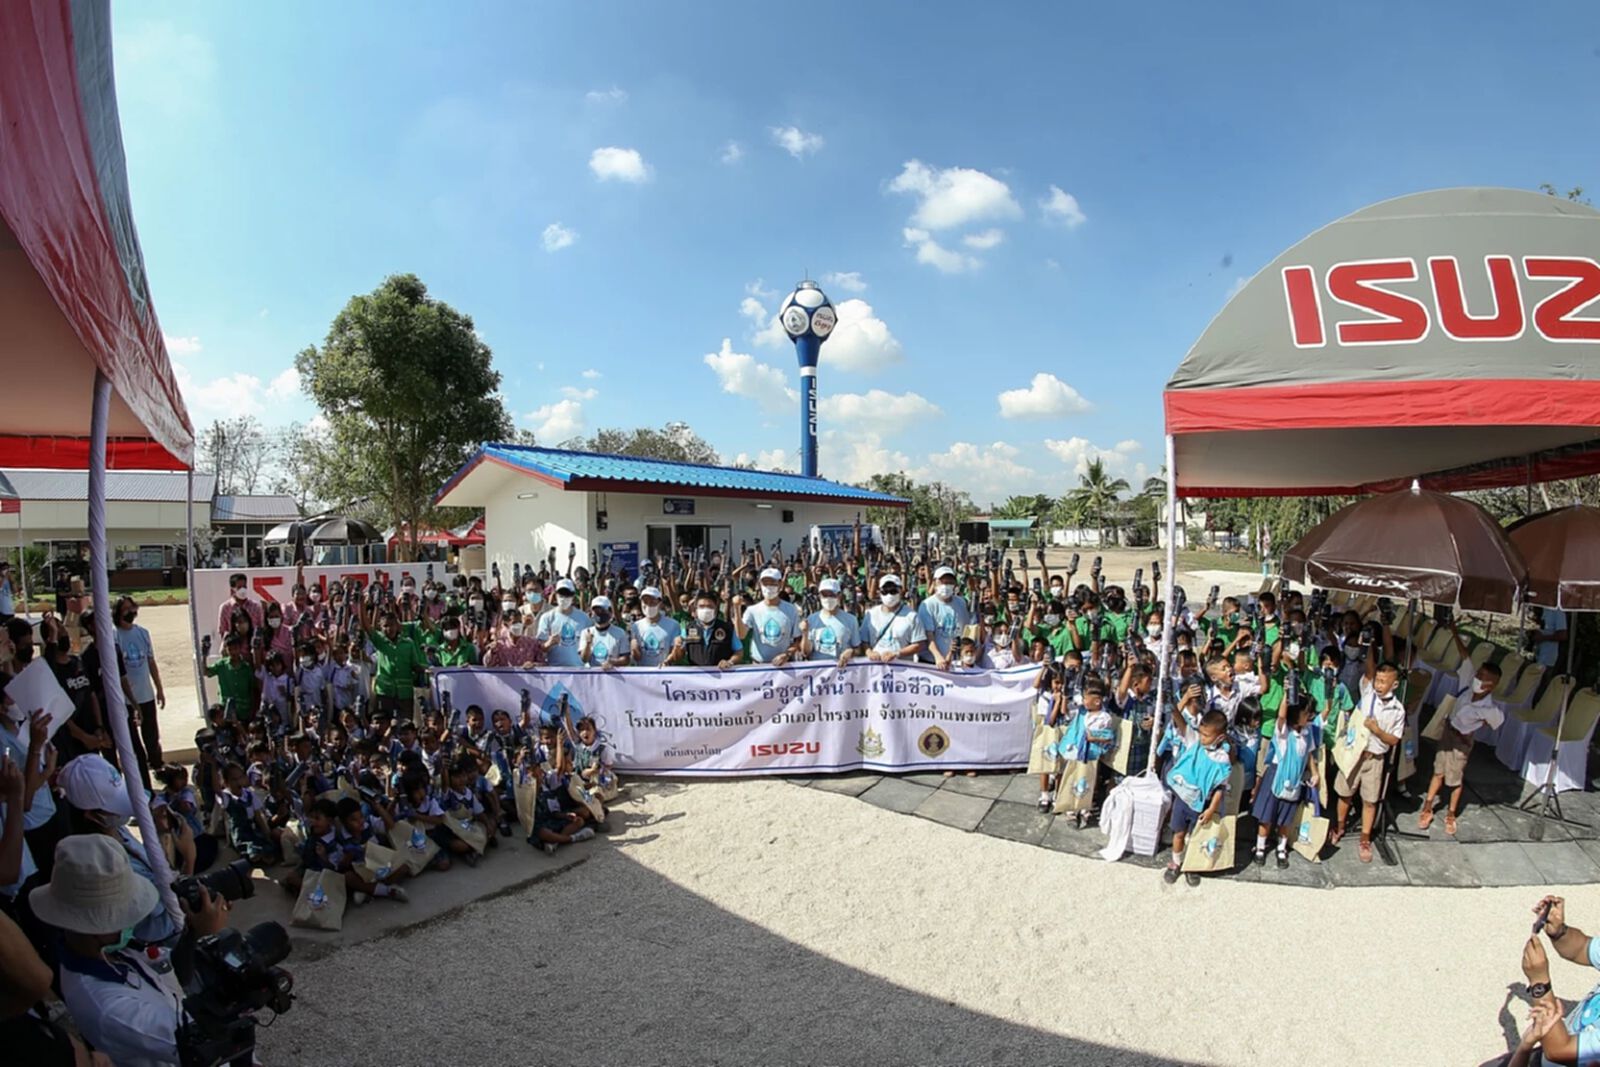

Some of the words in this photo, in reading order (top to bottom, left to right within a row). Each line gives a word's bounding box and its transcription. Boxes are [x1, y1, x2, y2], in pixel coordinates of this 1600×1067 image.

[1282, 254, 1600, 348] ISUZ
[662, 680, 742, 702] โครงการ
[625, 710, 762, 728] โรงเรียนบ้านบ่อแก้ว
[771, 704, 869, 725] อำเภอไทรงาม
[879, 703, 1010, 722] จังหวัดกำแพงเพชร
[750, 741, 821, 757] ISUZU
